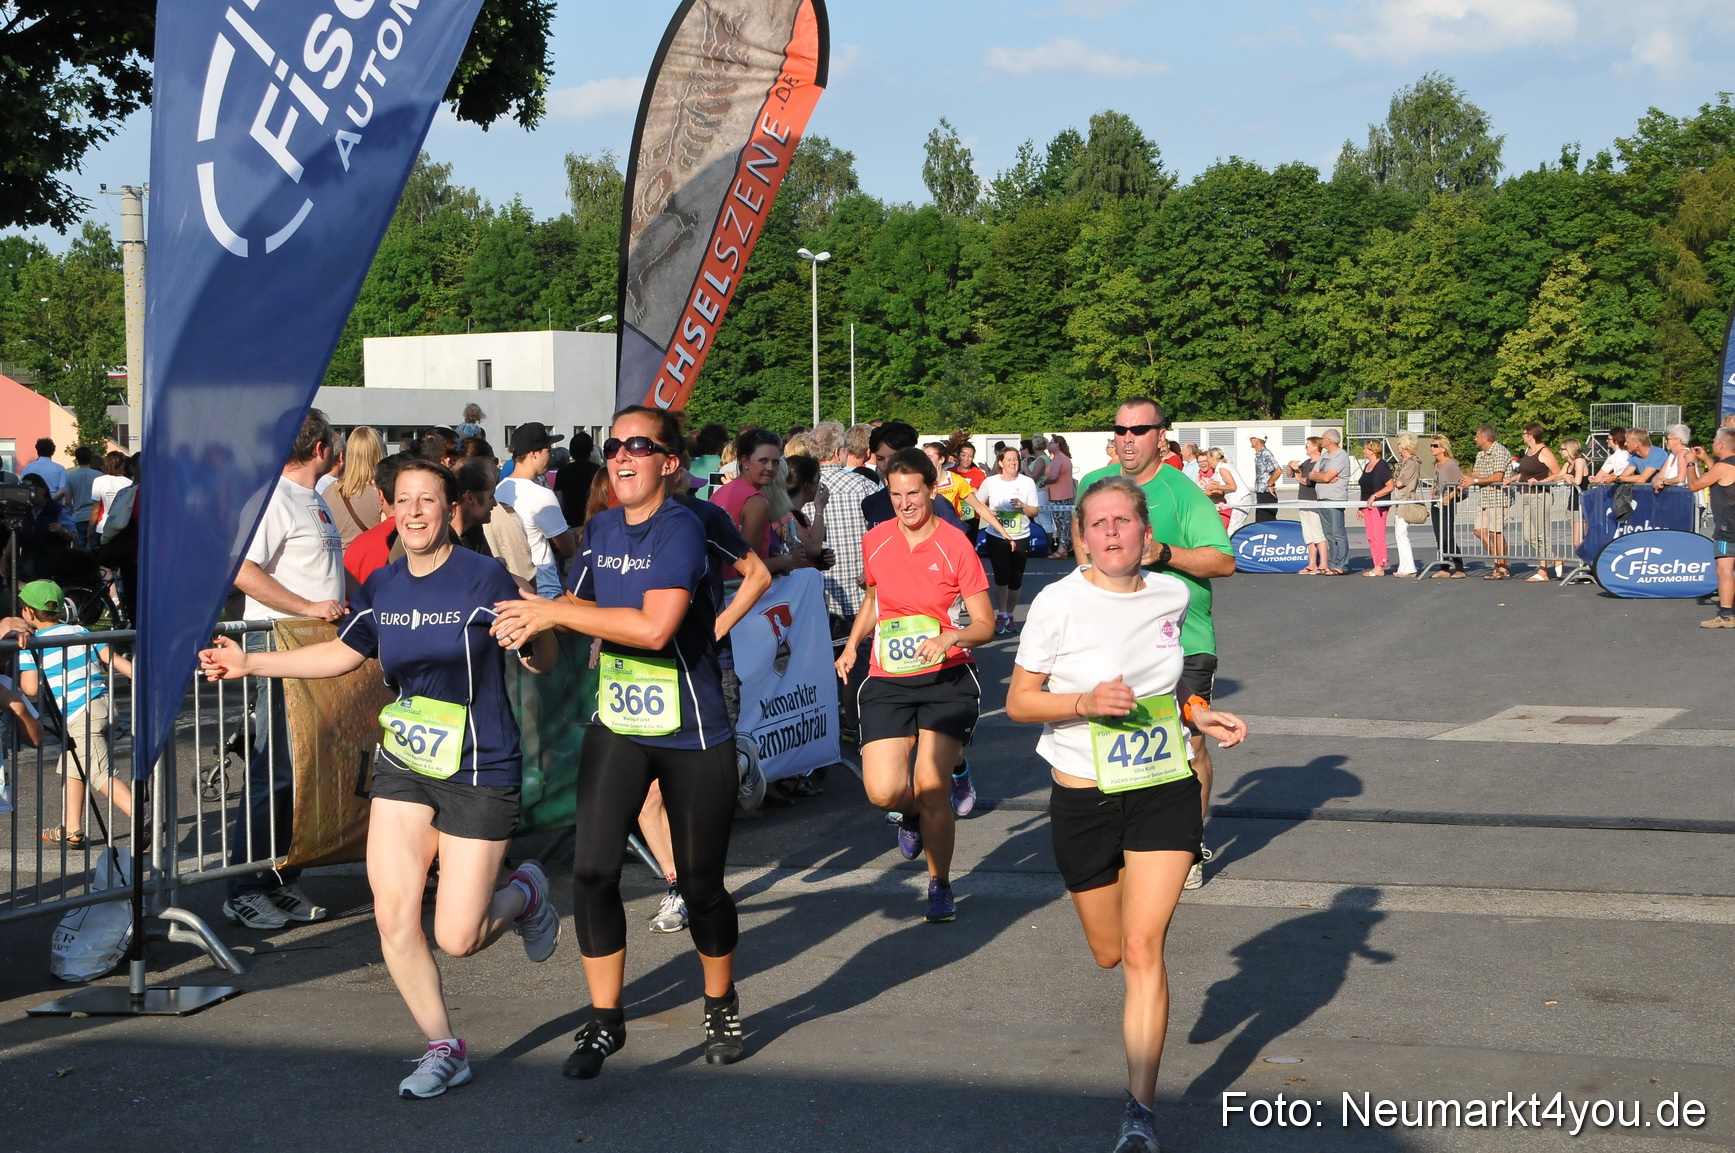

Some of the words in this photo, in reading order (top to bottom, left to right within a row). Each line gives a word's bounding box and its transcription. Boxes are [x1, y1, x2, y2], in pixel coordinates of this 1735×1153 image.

[1257, 555, 1309, 563] AUTOMOBILE
[1628, 559, 1711, 576] Fischer
[1636, 574, 1705, 584] AUTOMOBILE
[380, 612, 411, 626] EURO
[421, 610, 461, 626] POLES
[609, 682, 665, 716] 366
[759, 684, 817, 722] Neumarkter
[389, 719, 448, 758] 367
[756, 708, 828, 761] ammsbräu
[1107, 726, 1172, 768] 422
